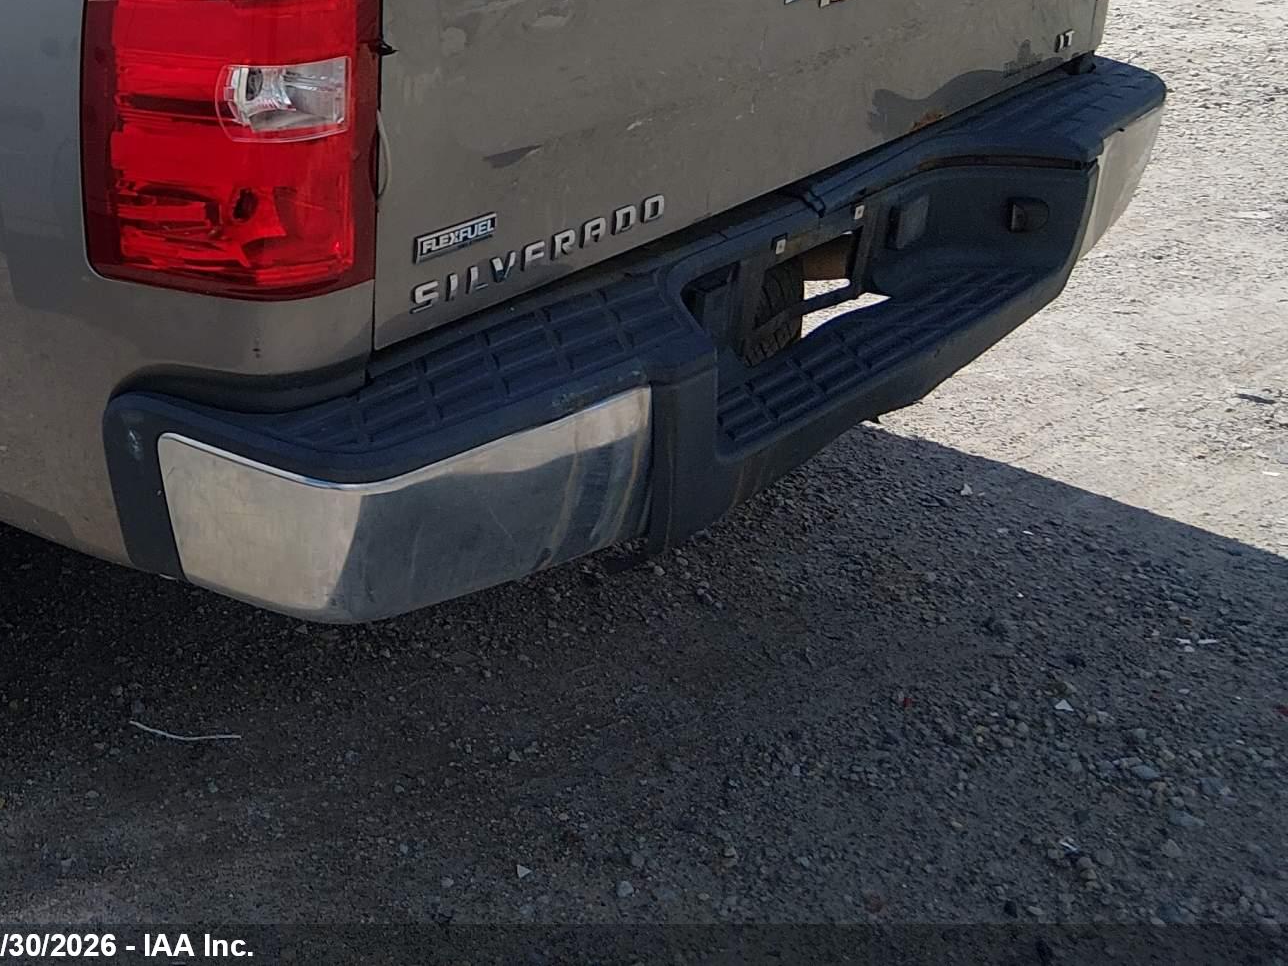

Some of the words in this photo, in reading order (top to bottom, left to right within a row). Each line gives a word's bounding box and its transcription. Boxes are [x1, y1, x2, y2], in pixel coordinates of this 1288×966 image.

[1056, 29, 1075, 51] LT
[411, 194, 666, 313] SILVERADO
[420, 217, 496, 256] FLEXFUEL
